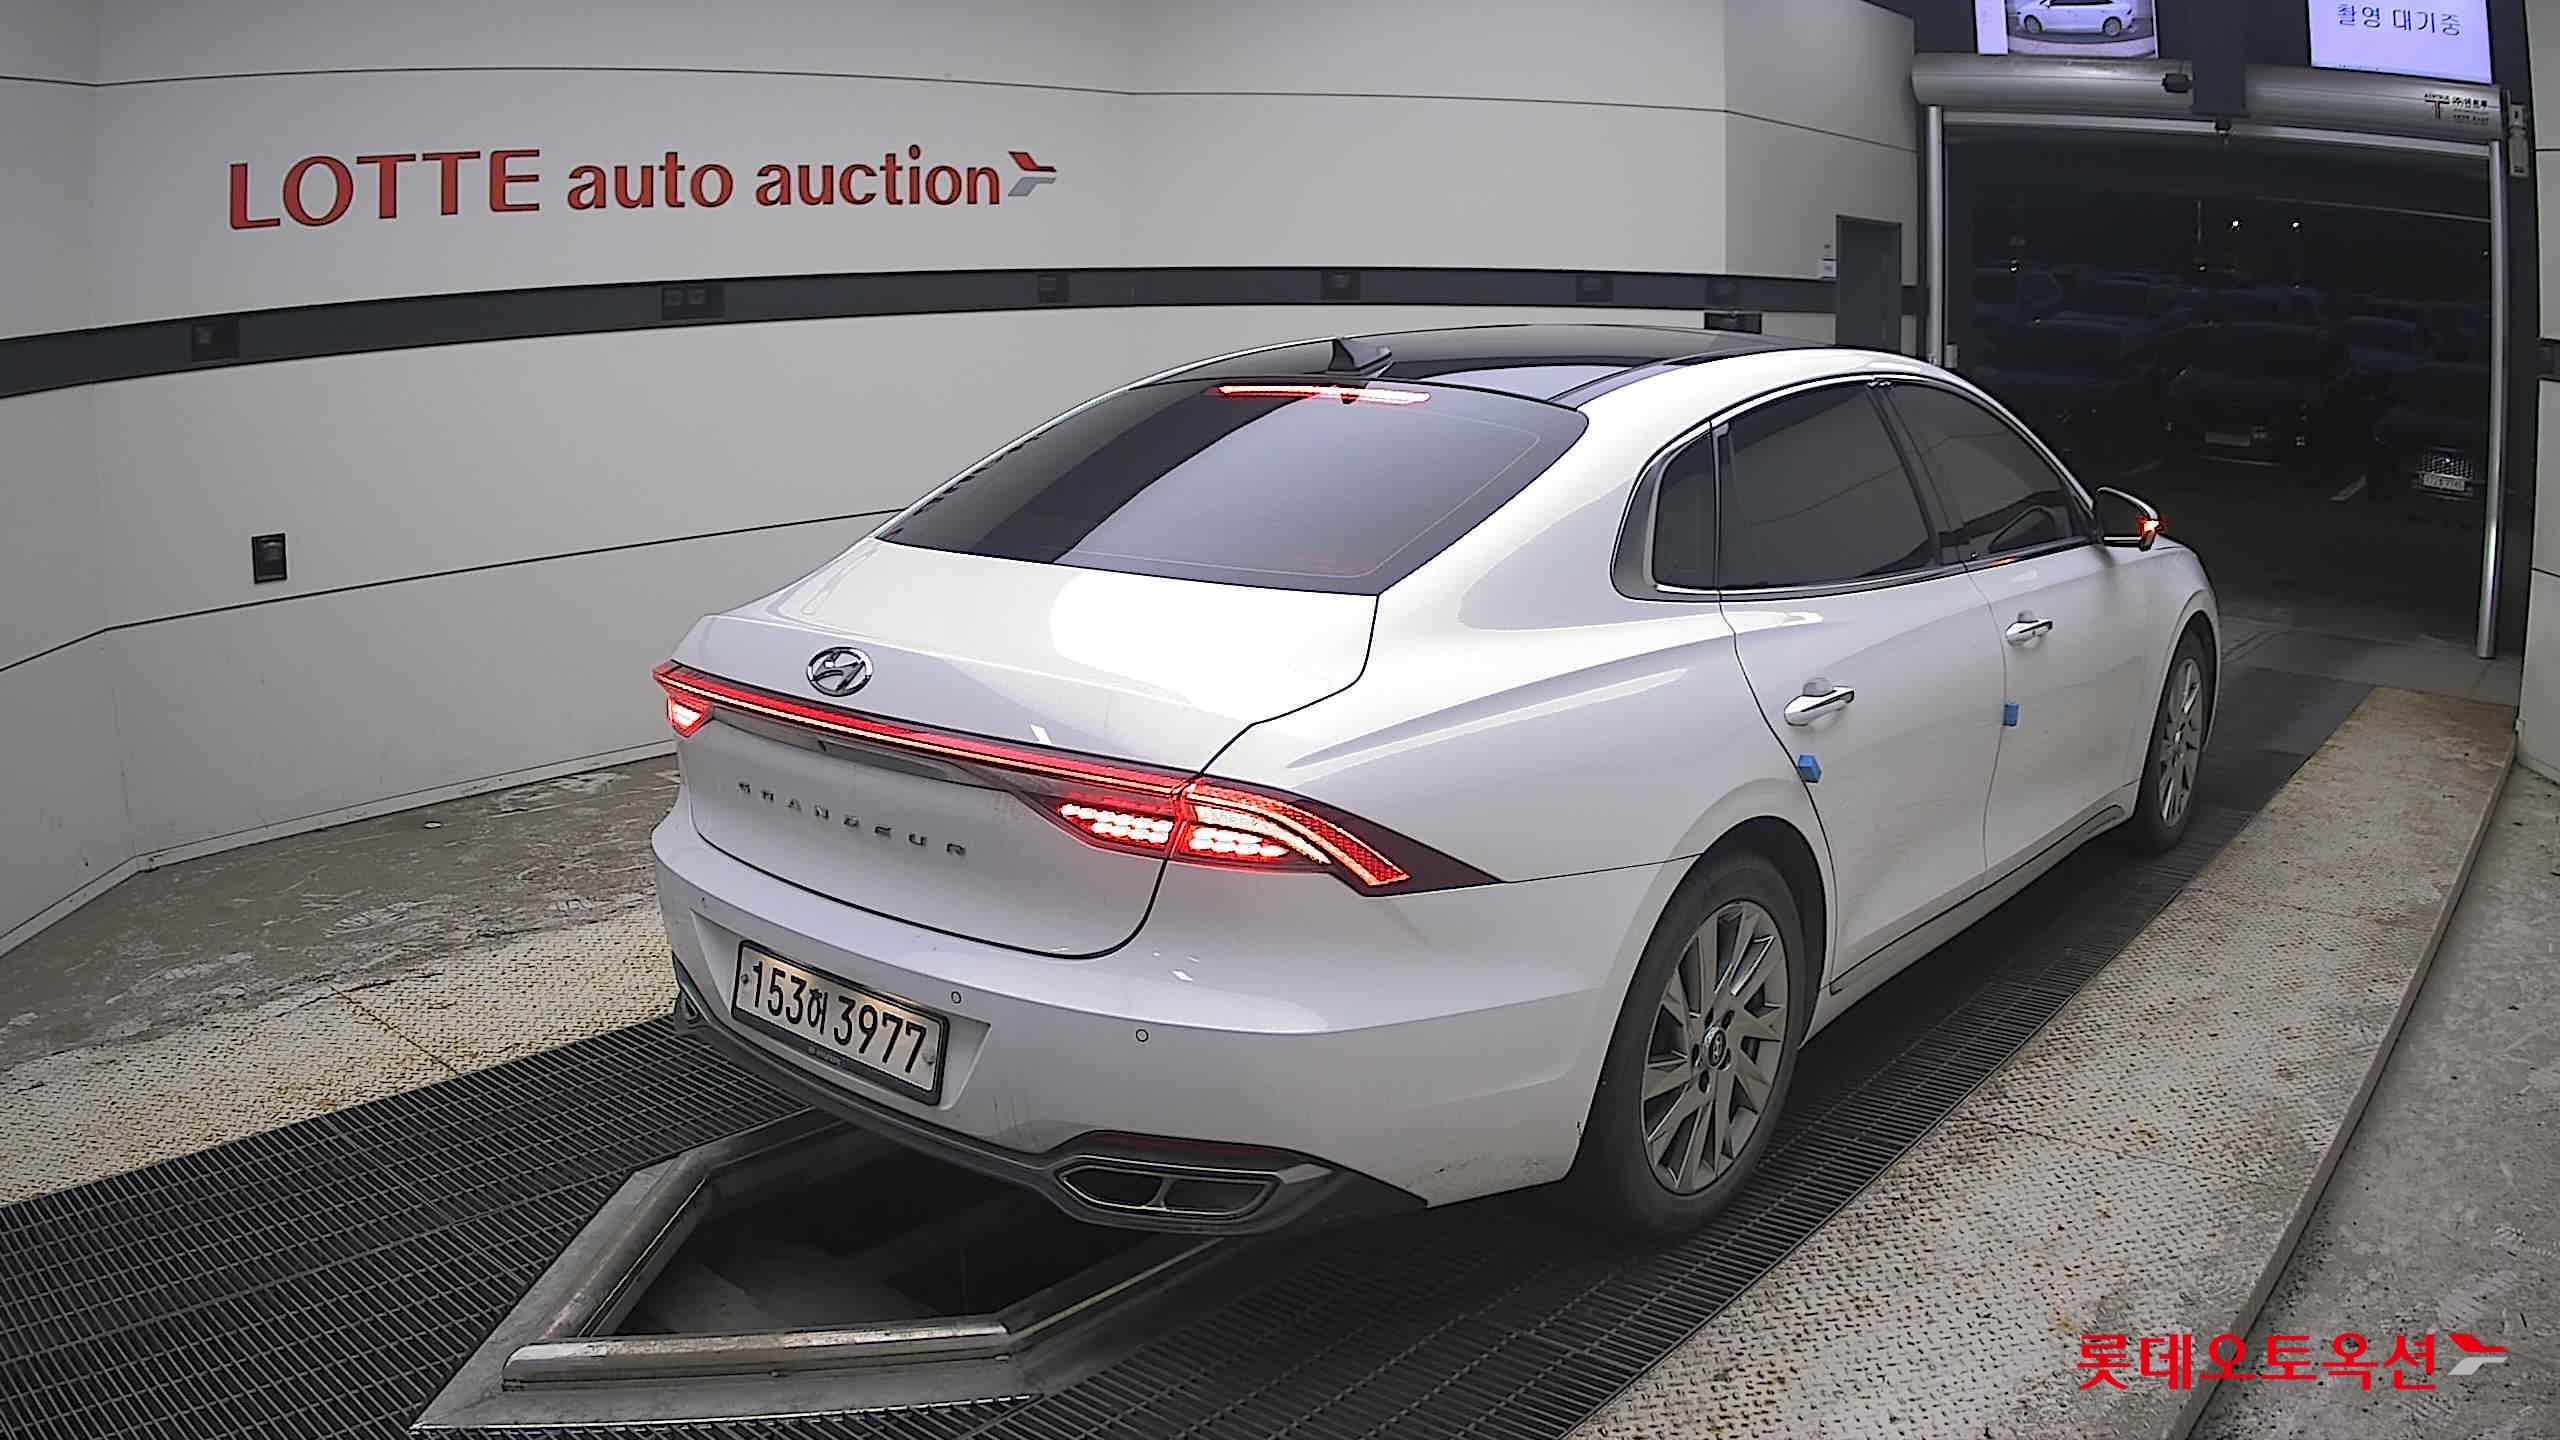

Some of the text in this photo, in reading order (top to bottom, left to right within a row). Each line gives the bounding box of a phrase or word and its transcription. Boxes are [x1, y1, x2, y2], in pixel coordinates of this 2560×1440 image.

[2337, 3, 2461, 36] 촬영 대기중
[229, 144, 1002, 230] LOTTE auto auction
